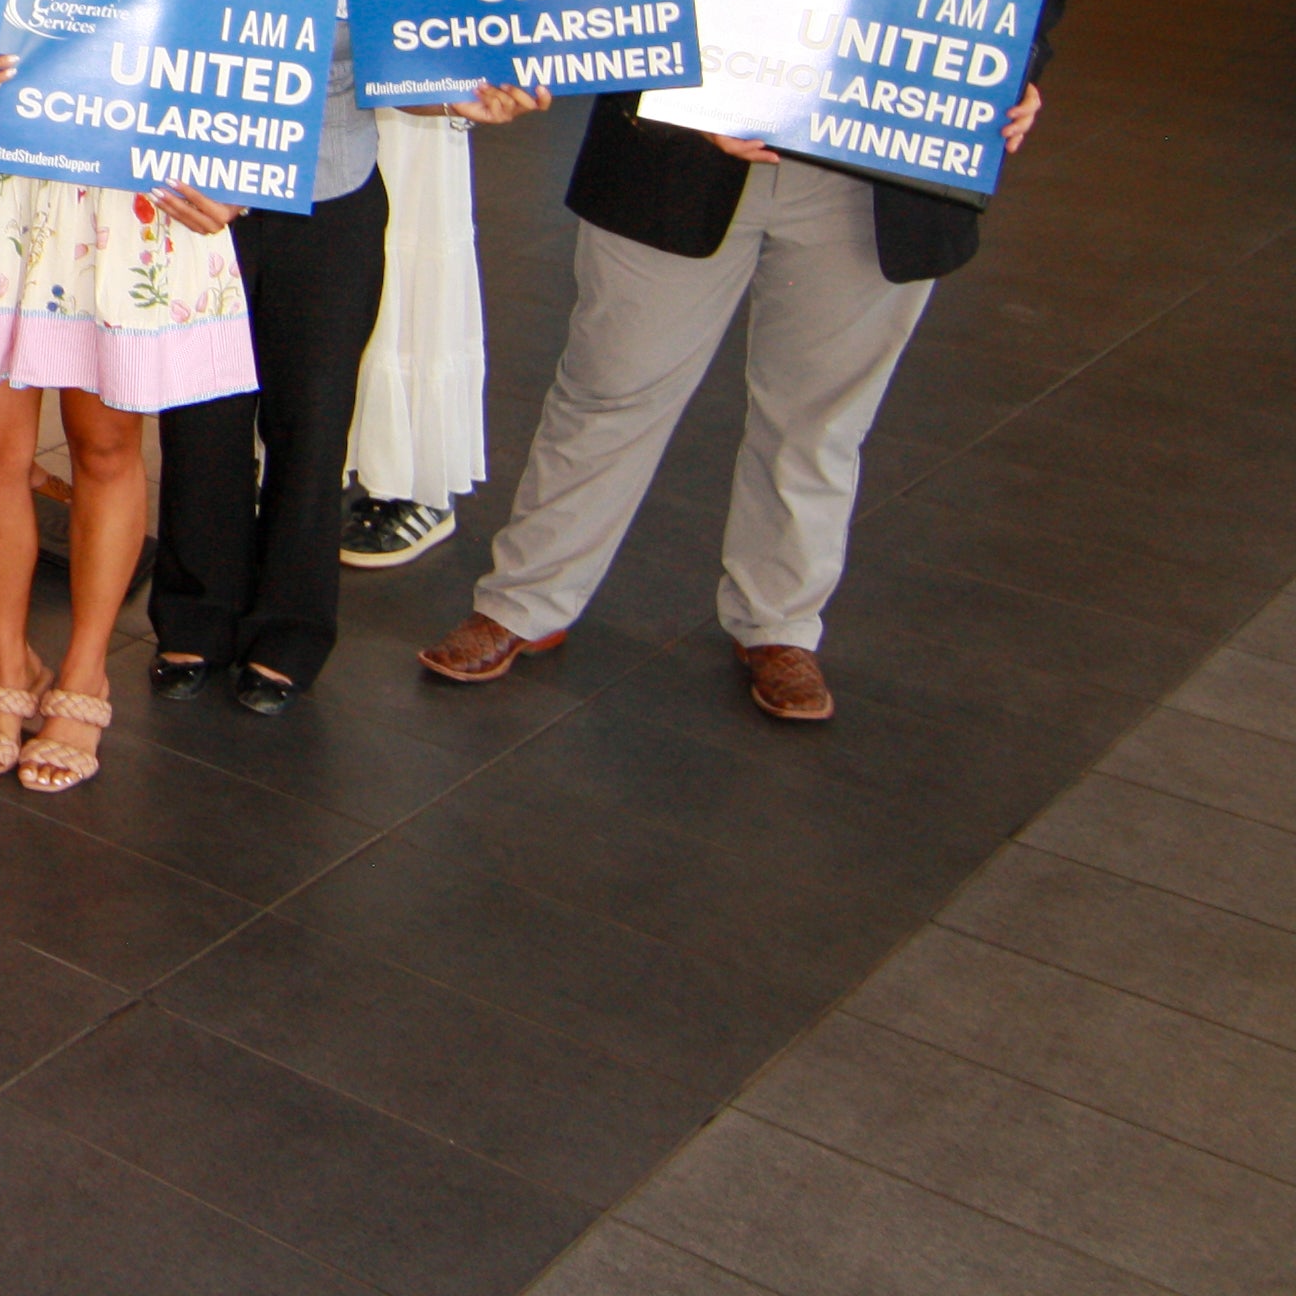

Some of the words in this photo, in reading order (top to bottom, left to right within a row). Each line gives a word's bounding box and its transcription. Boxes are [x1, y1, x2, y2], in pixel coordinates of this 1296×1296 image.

[28, 8, 96, 34] Services
[221, 7, 232, 41] I
[239, 10, 287, 49] AM
[295, 17, 315, 52] A
[392, 2, 679, 51] SCHOLARSHIP
[994, 2, 1016, 37] A
[110, 42, 312, 105] UNITED
[512, 42, 684, 87] WINNER!
[797, 9, 1009, 87] UNITED
[700, 44, 995, 132] SCHOLARSHIP
[16, 88, 304, 152] SCHOLARSHIP
[809, 111, 983, 177] WINNER!
[130, 146, 297, 199] WINNER!
